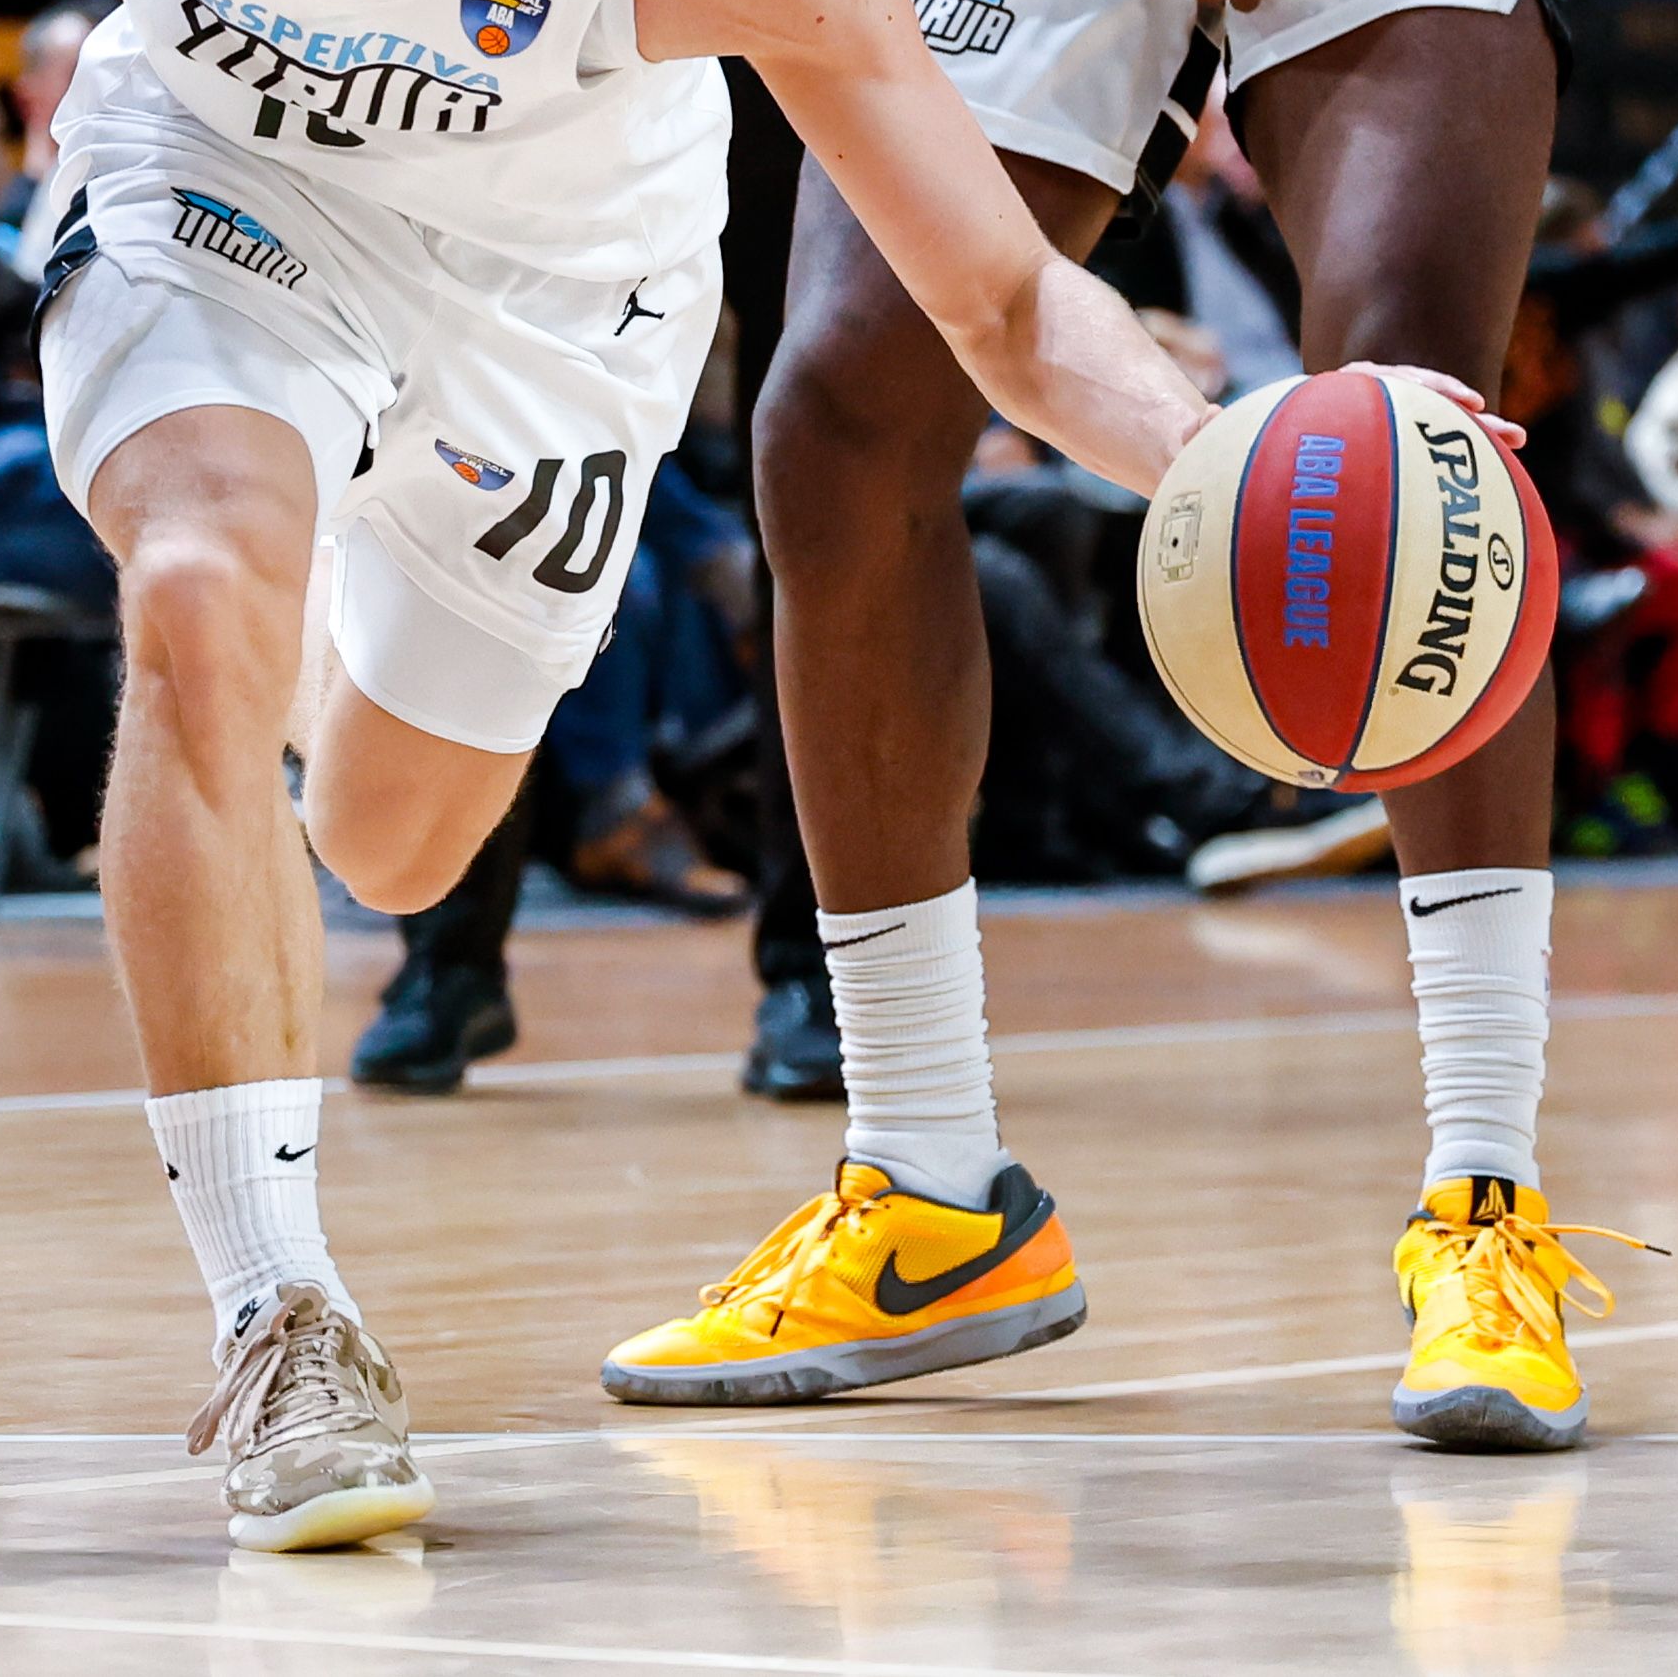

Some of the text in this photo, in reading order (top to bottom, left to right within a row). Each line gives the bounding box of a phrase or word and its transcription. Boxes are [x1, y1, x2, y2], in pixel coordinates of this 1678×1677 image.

[486, 3, 515, 29] ABA
[473, 449, 627, 594] 10
[1283, 433, 1344, 649] ABA LEAGUE
[1395, 421, 1480, 698] SPALDING
